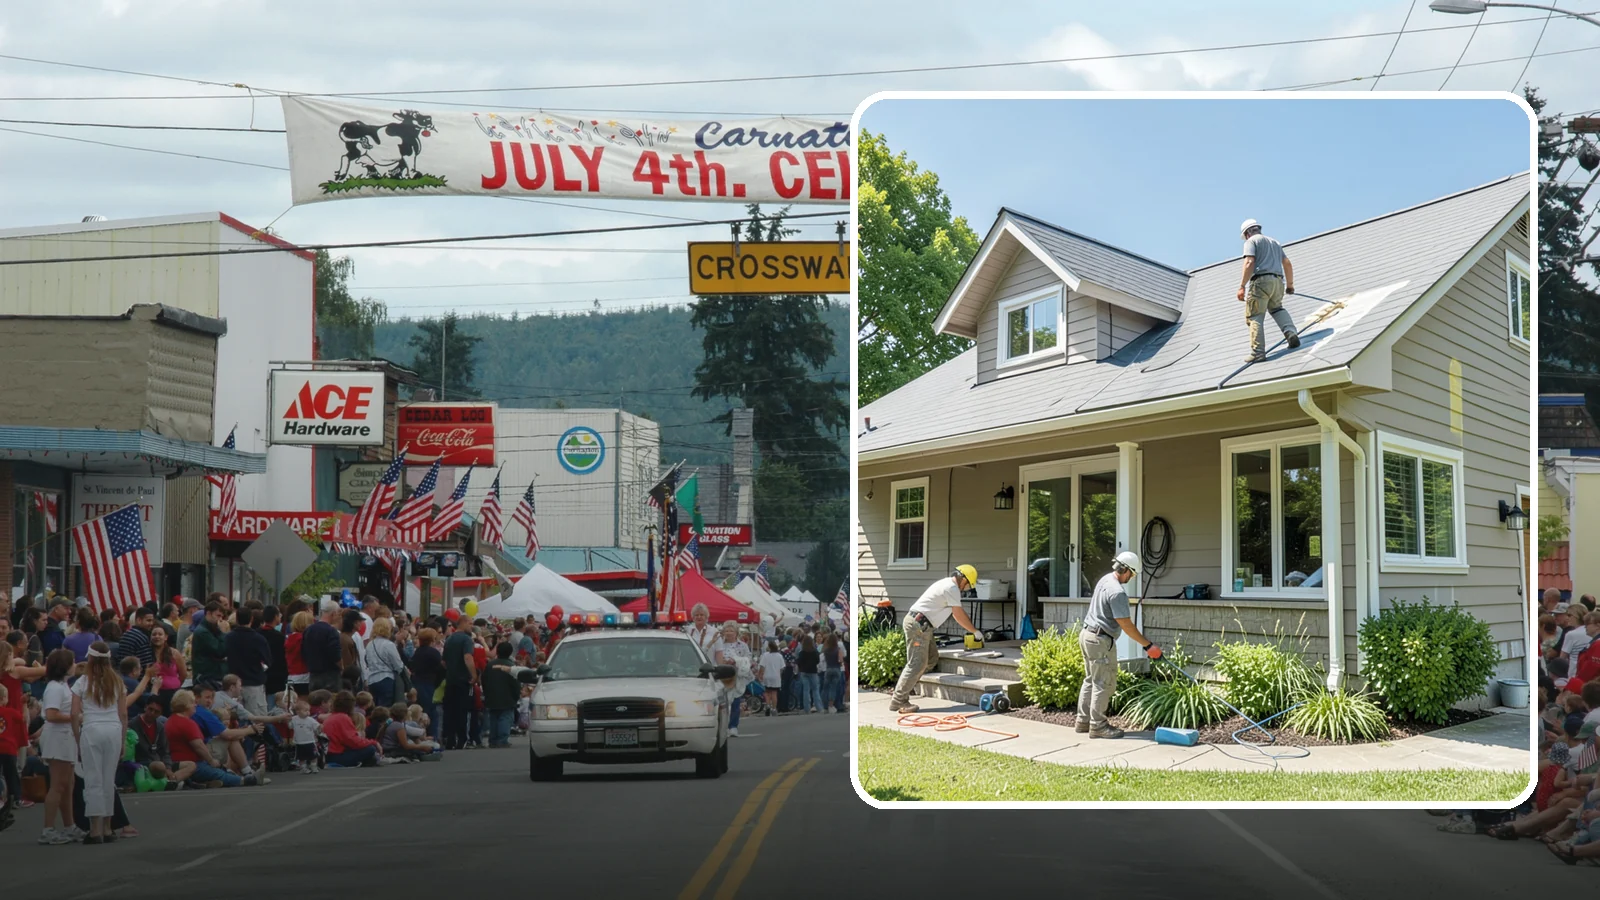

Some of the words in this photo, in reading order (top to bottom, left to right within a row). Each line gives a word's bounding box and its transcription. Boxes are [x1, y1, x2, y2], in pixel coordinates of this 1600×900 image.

[481, 140, 605, 192] JULY
[632, 150, 746, 198] 4th.
[697, 254, 850, 280] CROSSWA
[282, 380, 373, 420] ACE
[405, 409, 452, 422] CEDAR
[283, 421, 371, 436] Hardware
[416, 428, 477, 447] Coca-Cola
[353, 467, 386, 477] Simpl
[95, 485, 124, 495] Vincent
[126, 486, 136, 495] de
[137, 486, 155, 495] Paul
[213, 516, 330, 535] HARDARE
[688, 526, 741, 535] CRNATION
[699, 535, 730, 543] GLASS
